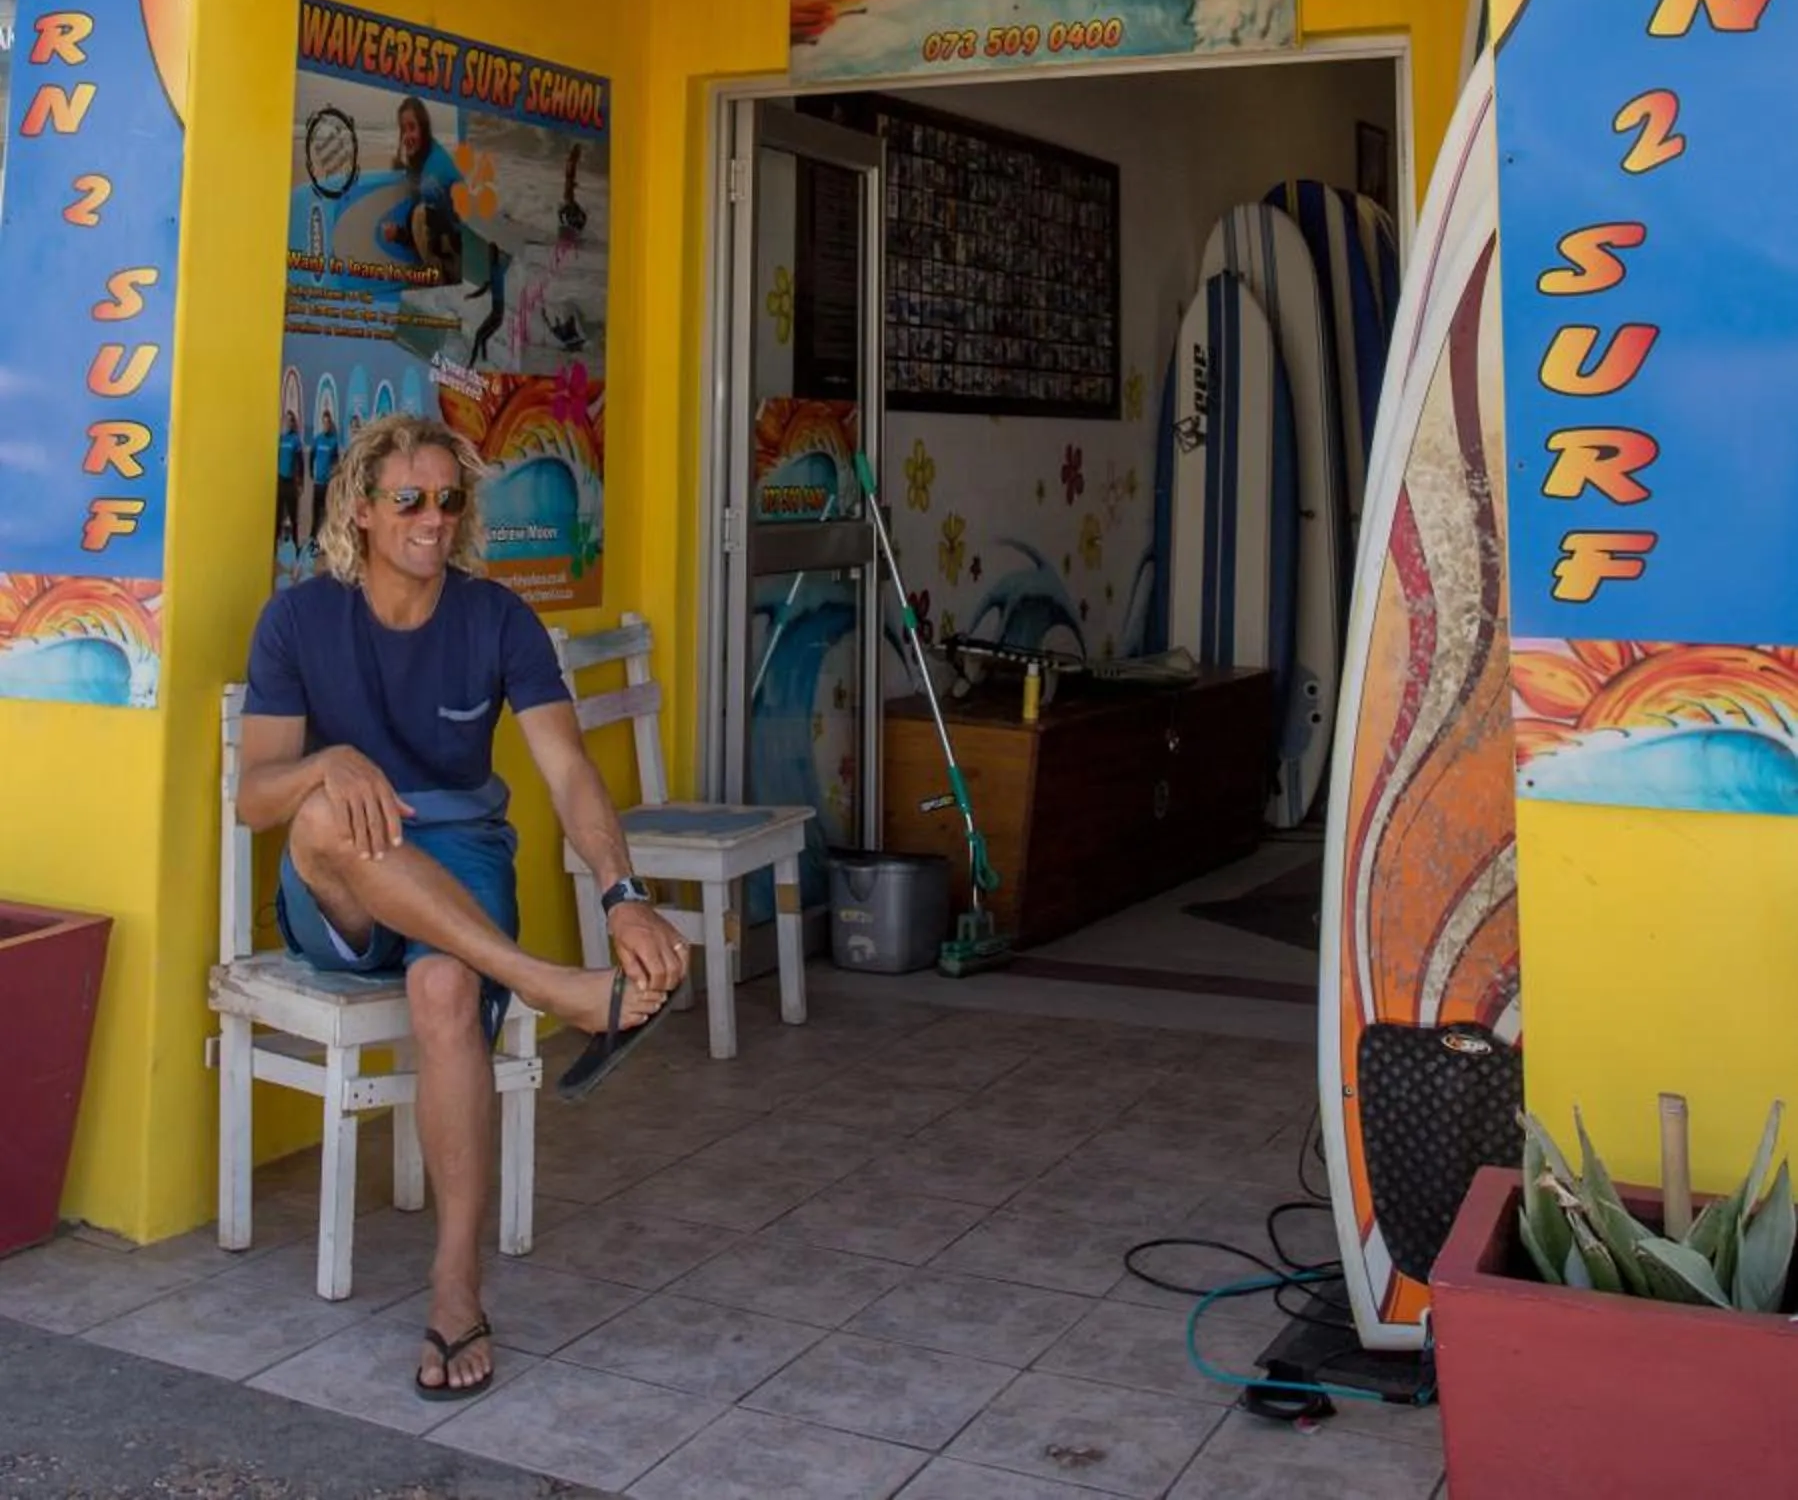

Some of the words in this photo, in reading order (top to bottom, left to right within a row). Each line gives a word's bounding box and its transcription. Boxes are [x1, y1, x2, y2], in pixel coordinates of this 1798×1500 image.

[301, 2, 459, 94] WAVECREST
[461, 48, 523, 109] SURF
[523, 66, 605, 130] SCHOOL
[923, 29, 978, 62] 073
[984, 23, 1040, 57] 509
[1047, 17, 1124, 52] 0400
[1612, 88, 1686, 176] 2
[62, 174, 112, 228] 2
[286, 250, 325, 274] Want
[80, 266, 159, 551] SURF
[1536, 222, 1661, 604] SURF
